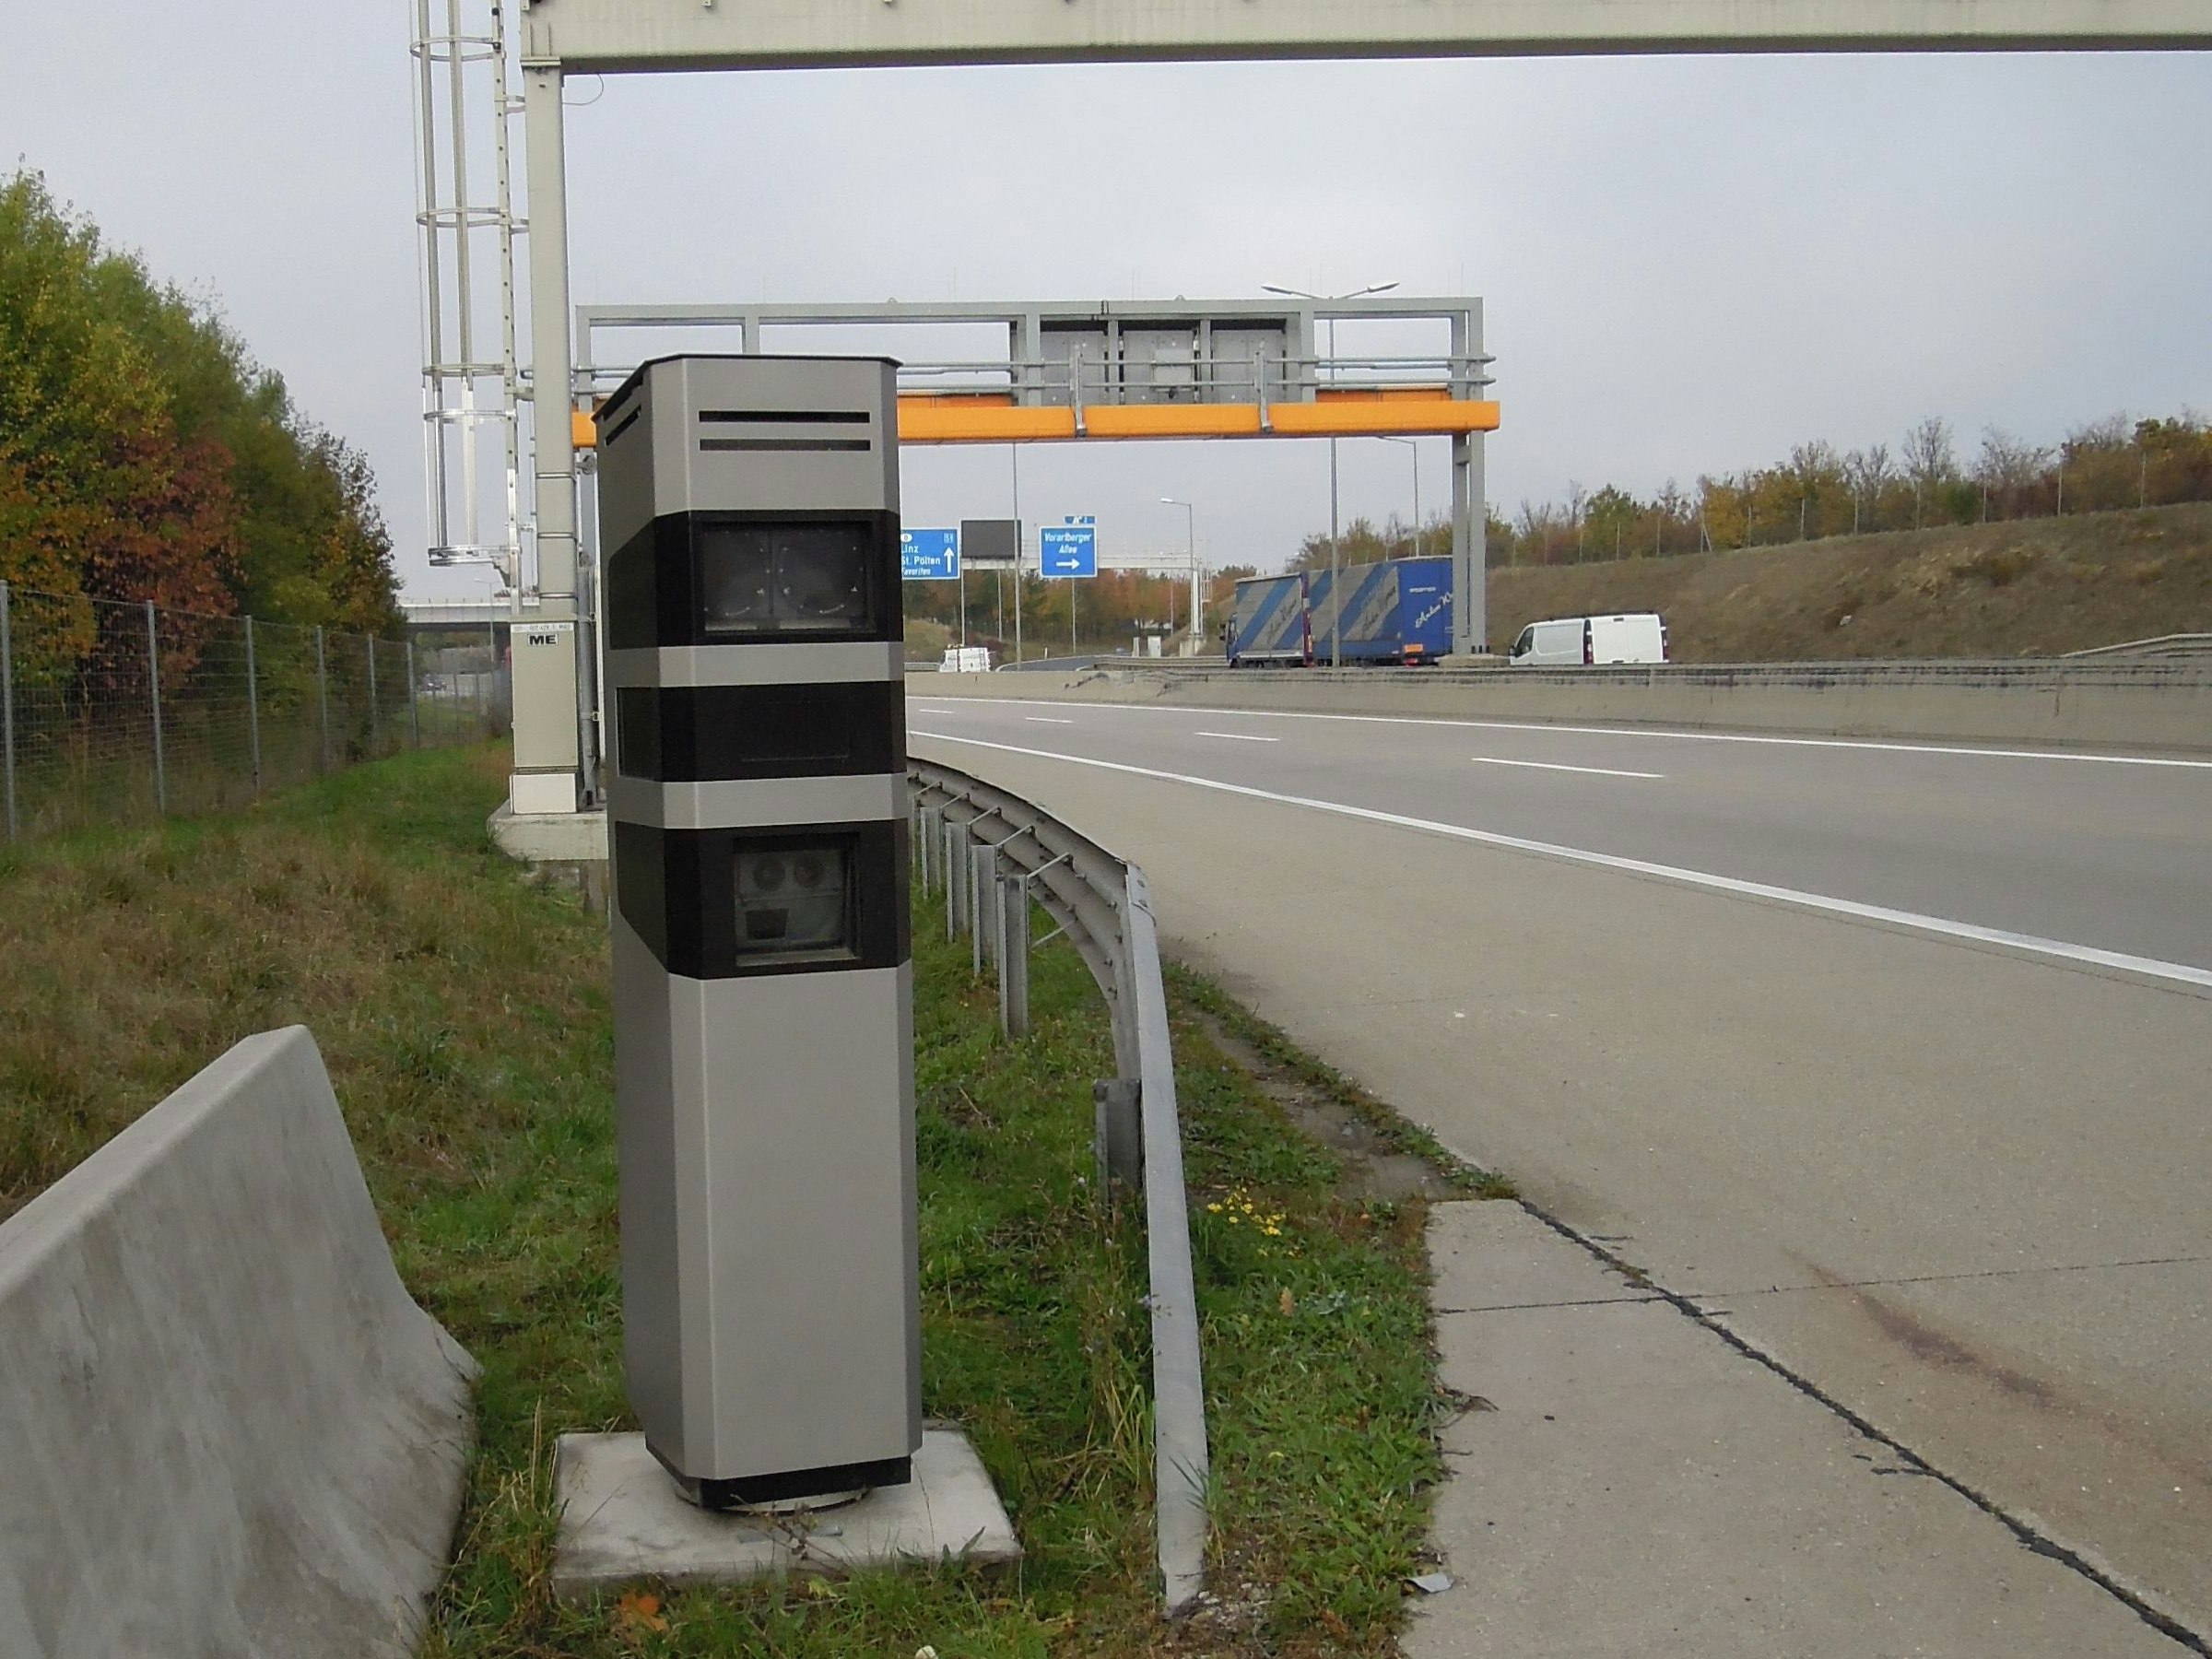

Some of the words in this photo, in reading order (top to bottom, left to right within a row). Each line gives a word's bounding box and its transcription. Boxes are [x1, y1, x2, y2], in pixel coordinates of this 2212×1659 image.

[1044, 531, 1092, 544] Vorarlberger
[1058, 544, 1077, 554] Allee
[529, 635, 557, 645] ME
